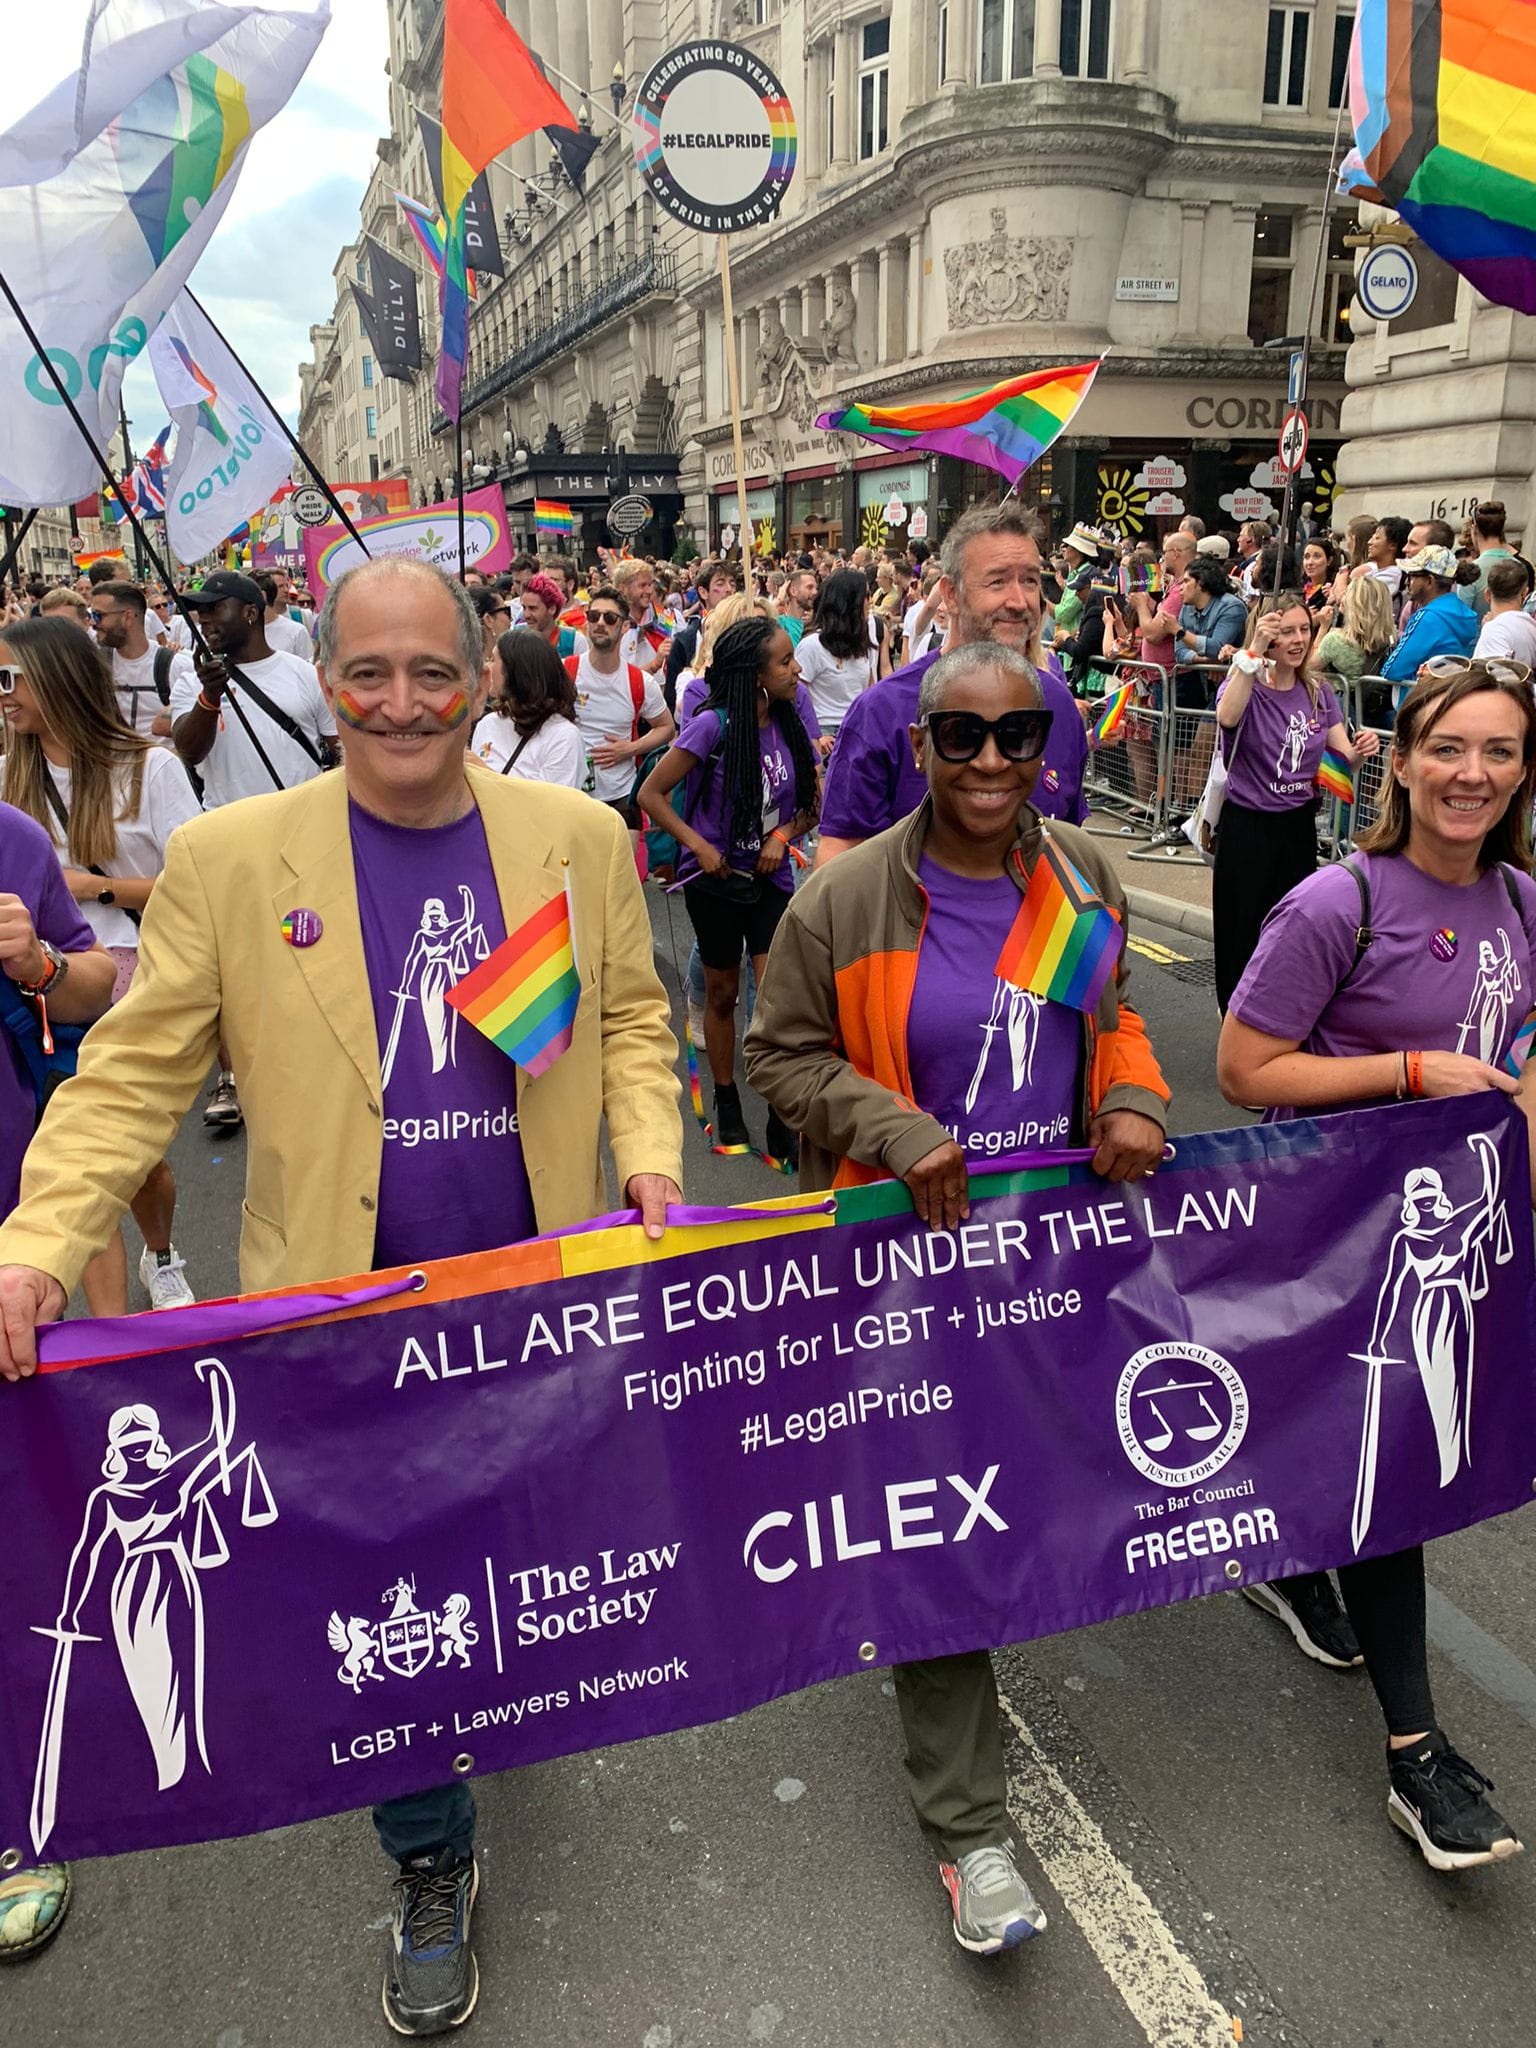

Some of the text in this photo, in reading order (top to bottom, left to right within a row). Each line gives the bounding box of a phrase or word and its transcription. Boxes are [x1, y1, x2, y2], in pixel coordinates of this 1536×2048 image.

[646, 46, 781, 103] CELEBRATING 50 YEARS
[662, 133, 771, 148] #LEGALPRIDE
[653, 175, 785, 229] OF PRIDE IN THE U.K.
[1120, 279, 1134, 289] AIR
[1136, 280, 1162, 290] STREET
[1370, 276, 1407, 288] GELATO
[389, 278, 406, 349] DILLY
[554, 477, 593, 489] THE
[1430, 497, 1478, 519] 16-18
[274, 554, 296, 566] WE
[394, 1184, 1258, 1389] ALL ARE EQUAL UNDER THE LAW
[624, 1289, 1082, 1411] Fighting for LGBT + justice
[739, 1379, 953, 1454] #LegalPride
[1119, 1345, 1246, 1453] THE GENERAL COUNCIL OF THE BAR
[1143, 1443, 1234, 1483] JUSTICE FOR ALL
[743, 1464, 1009, 1584] CILEX
[1134, 1479, 1256, 1521] The Bar Council
[1125, 1507, 1280, 1574] FREEBAR
[509, 1542, 682, 1606] The Law
[517, 1587, 658, 1647] Society
[331, 1656, 689, 1765] LGBT + Lawyers Network
